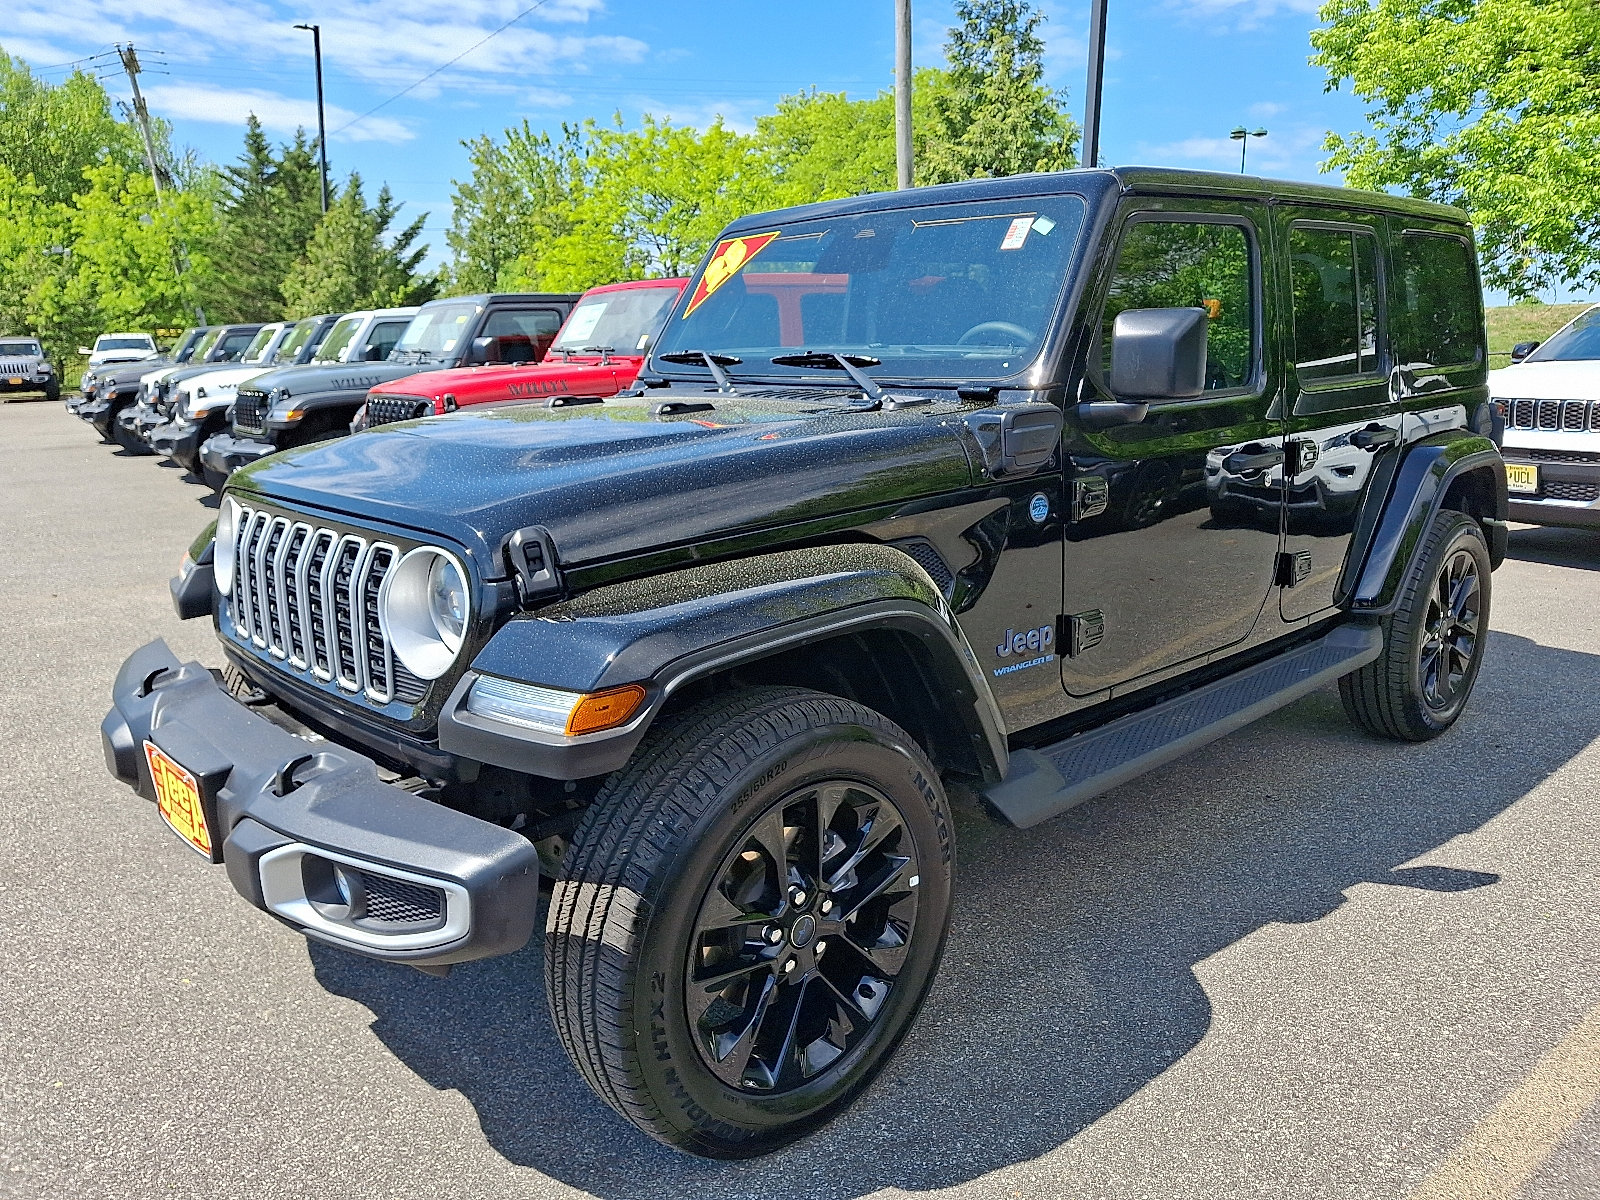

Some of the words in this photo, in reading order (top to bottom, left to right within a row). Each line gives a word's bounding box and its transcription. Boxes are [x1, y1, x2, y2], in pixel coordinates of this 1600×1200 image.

[506, 379, 569, 396] WILLYS
[1513, 470, 1533, 485] UCL
[996, 625, 1054, 658] Jeep
[993, 656, 1045, 677] WRANGLER
[158, 756, 203, 840] Jeep
[730, 760, 788, 816] 255/60R20
[912, 770, 951, 866] NEXEN
[651, 971, 666, 993] 2
[651, 1001, 672, 1062] HTX
